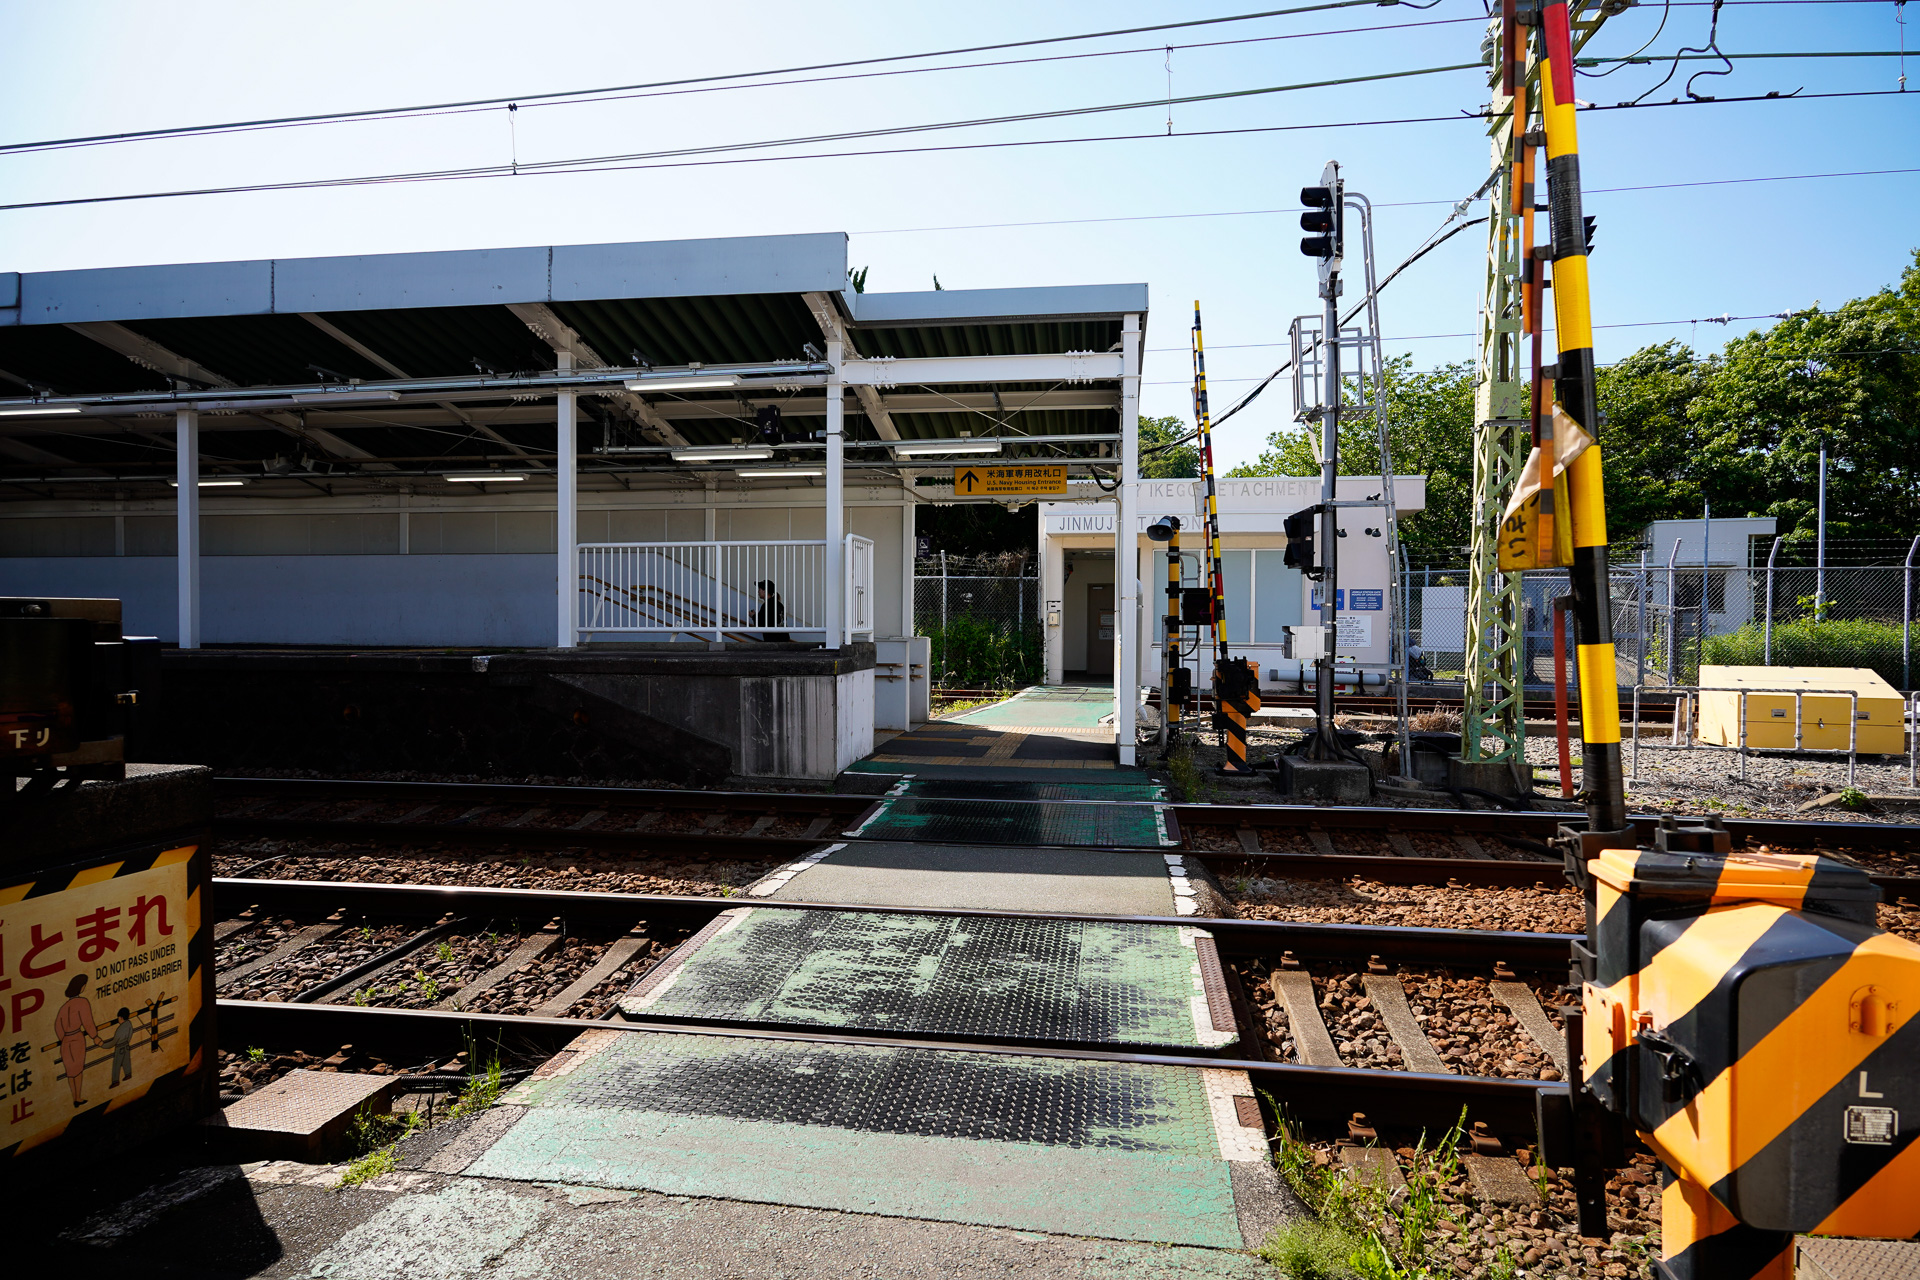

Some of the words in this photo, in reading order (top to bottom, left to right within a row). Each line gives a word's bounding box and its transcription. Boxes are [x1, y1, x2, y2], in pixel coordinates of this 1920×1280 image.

[1218, 481, 1320, 497] ETACHMENT
[1060, 517, 1112, 531] JINMUJ
[1505, 502, 1526, 558] さい
[0, 895, 174, 991] とまれ
[96, 967, 108, 980] DO
[110, 960, 126, 976] NOT
[128, 954, 148, 970] PASS
[150, 943, 176, 962] UNDER
[96, 986, 111, 999] THE
[113, 971, 150, 994] CROSSING
[151, 959, 182, 980] BARRIER
[0, 988, 45, 1035] P
[1859, 1071, 1883, 1098] L
[11, 1097, 35, 1125] 止
